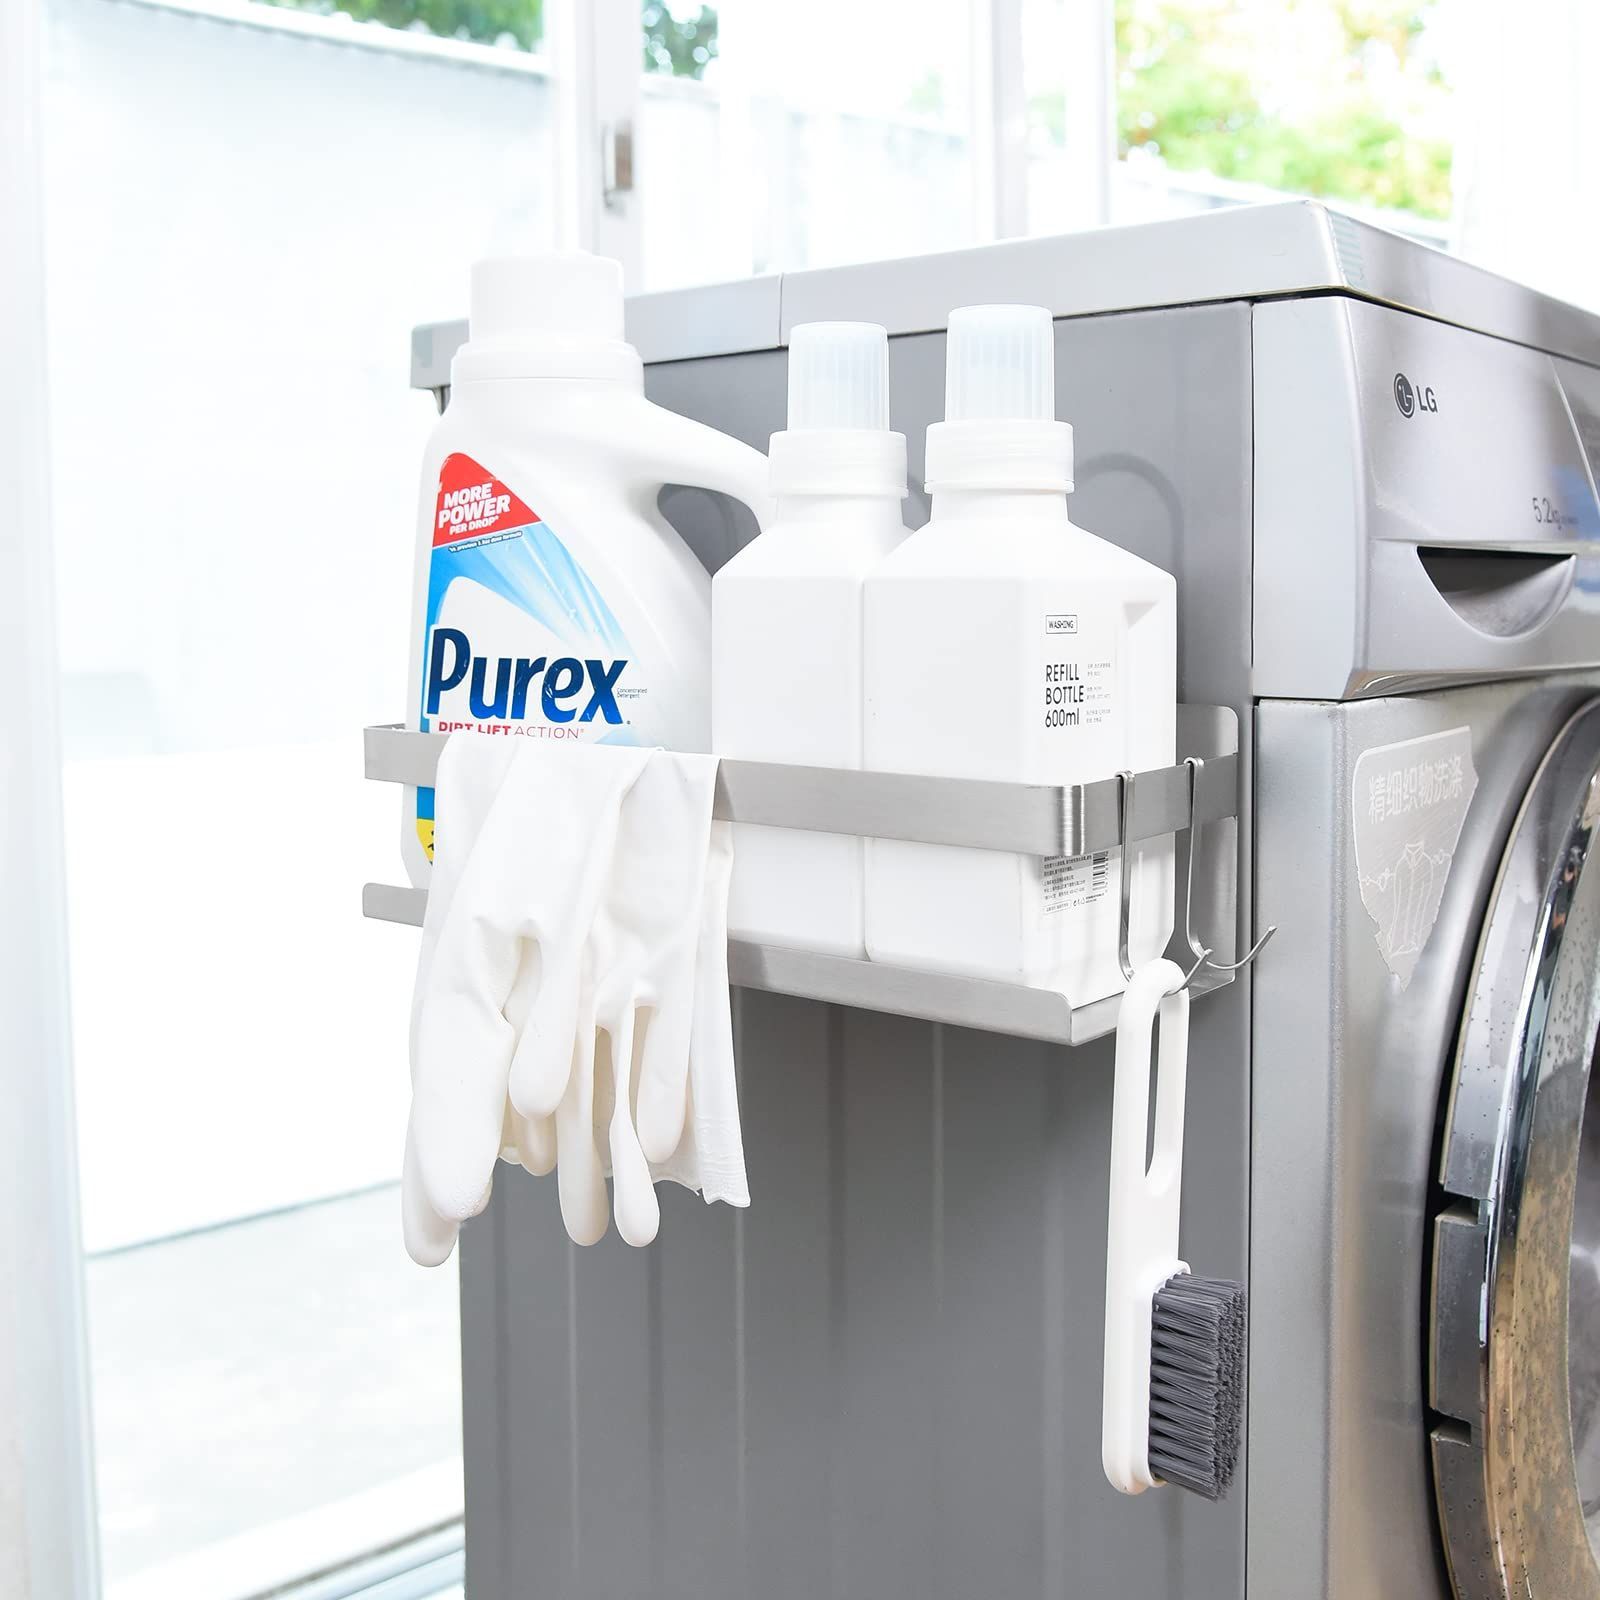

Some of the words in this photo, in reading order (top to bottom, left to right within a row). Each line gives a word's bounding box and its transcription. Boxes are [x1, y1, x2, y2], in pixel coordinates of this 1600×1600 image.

[1416, 385, 1438, 413] LG
[444, 482, 493, 509] MORE
[438, 494, 511, 529] POWER
[449, 523, 468, 535] PER
[1048, 620, 1074, 629] WASHING
[427, 628, 629, 725] Purex
[1046, 663, 1080, 682] REFILL
[1046, 685, 1085, 705] BOTTLE
[1045, 707, 1080, 728] 600ml
[478, 723, 512, 736] LIFT
